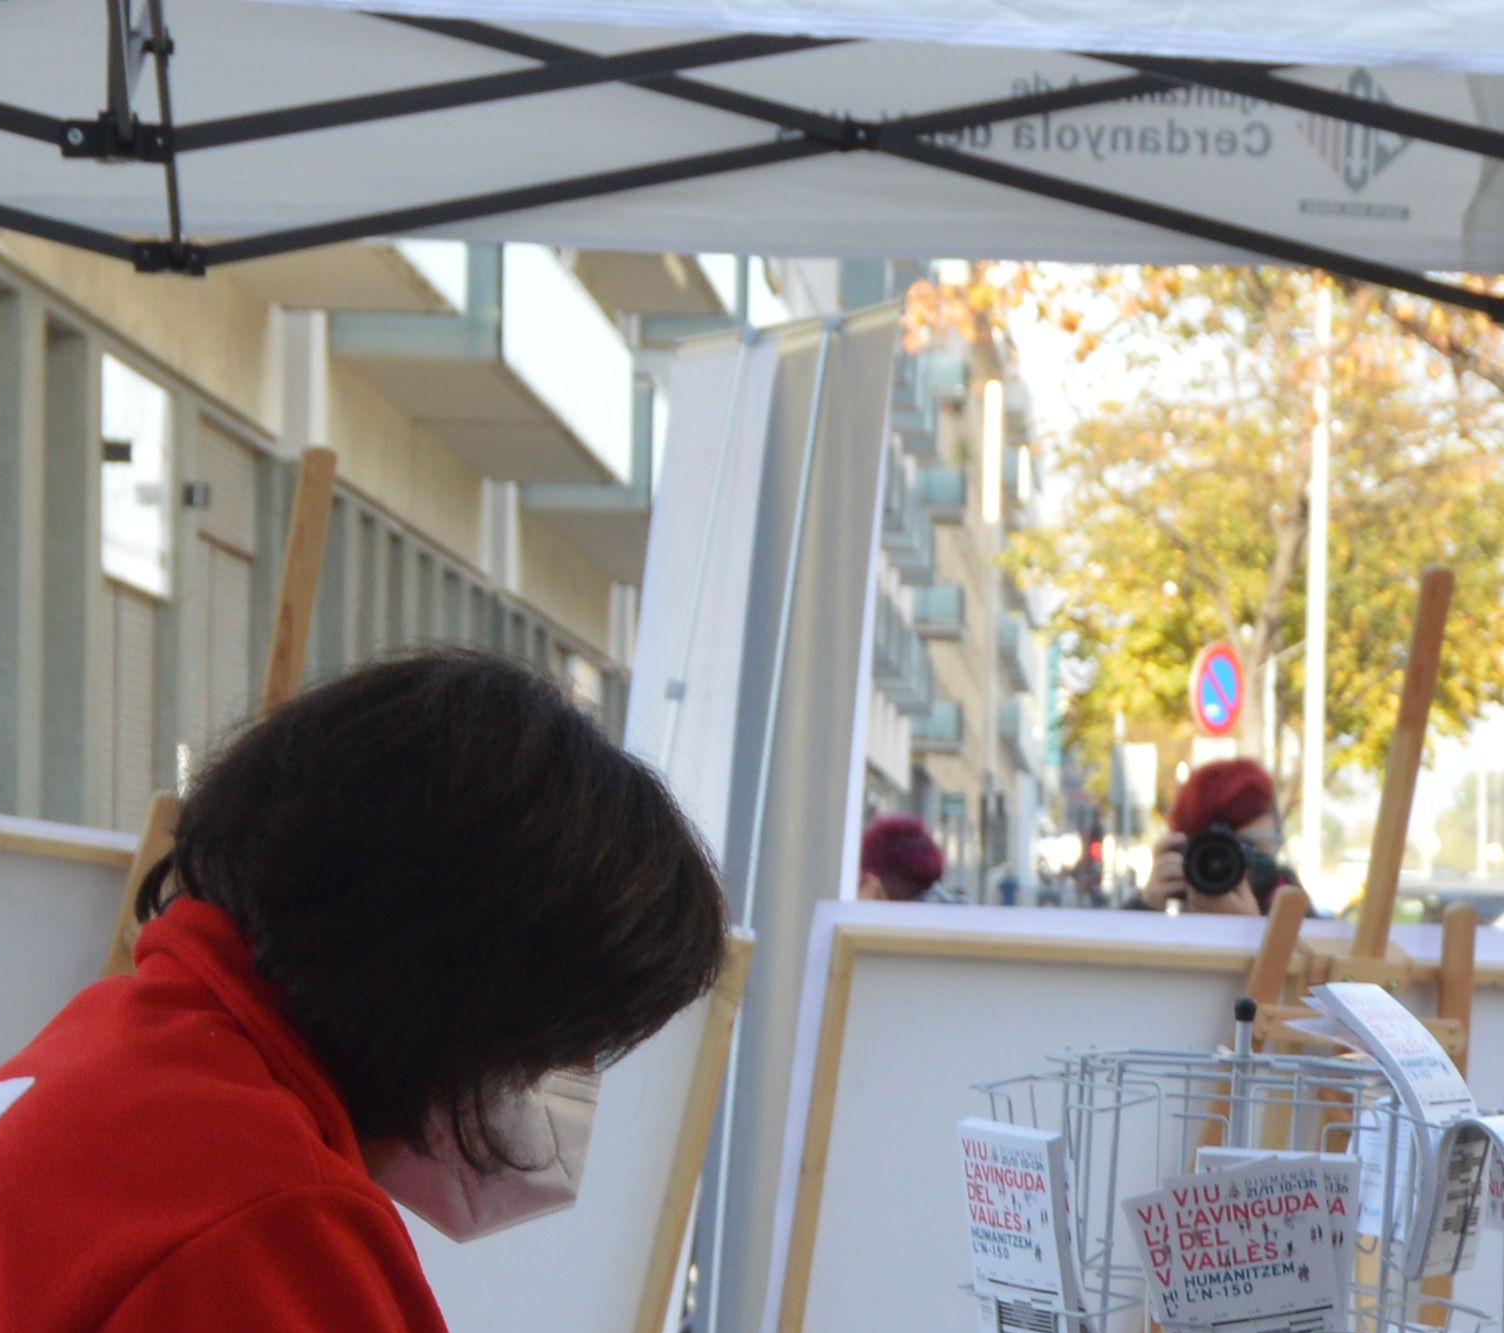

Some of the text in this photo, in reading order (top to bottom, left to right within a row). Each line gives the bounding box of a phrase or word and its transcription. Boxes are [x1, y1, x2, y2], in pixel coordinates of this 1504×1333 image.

[962, 1138, 988, 1160] VIU
[964, 1160, 1046, 1193] L'AVINGUDA
[967, 1181, 994, 1205] DEL
[1172, 1183, 1220, 1207] VIU
[969, 1204, 1023, 1232] VALLÈS
[1176, 1192, 1319, 1229] L'AVINGUDA
[971, 1225, 1033, 1250] HUMANITZEM
[1179, 1228, 1230, 1251] DEL
[1182, 1239, 1279, 1272] VALLÈS
[1184, 1262, 1295, 1288] HUMANITZEM
[1186, 1282, 1254, 1303] L'N-150
